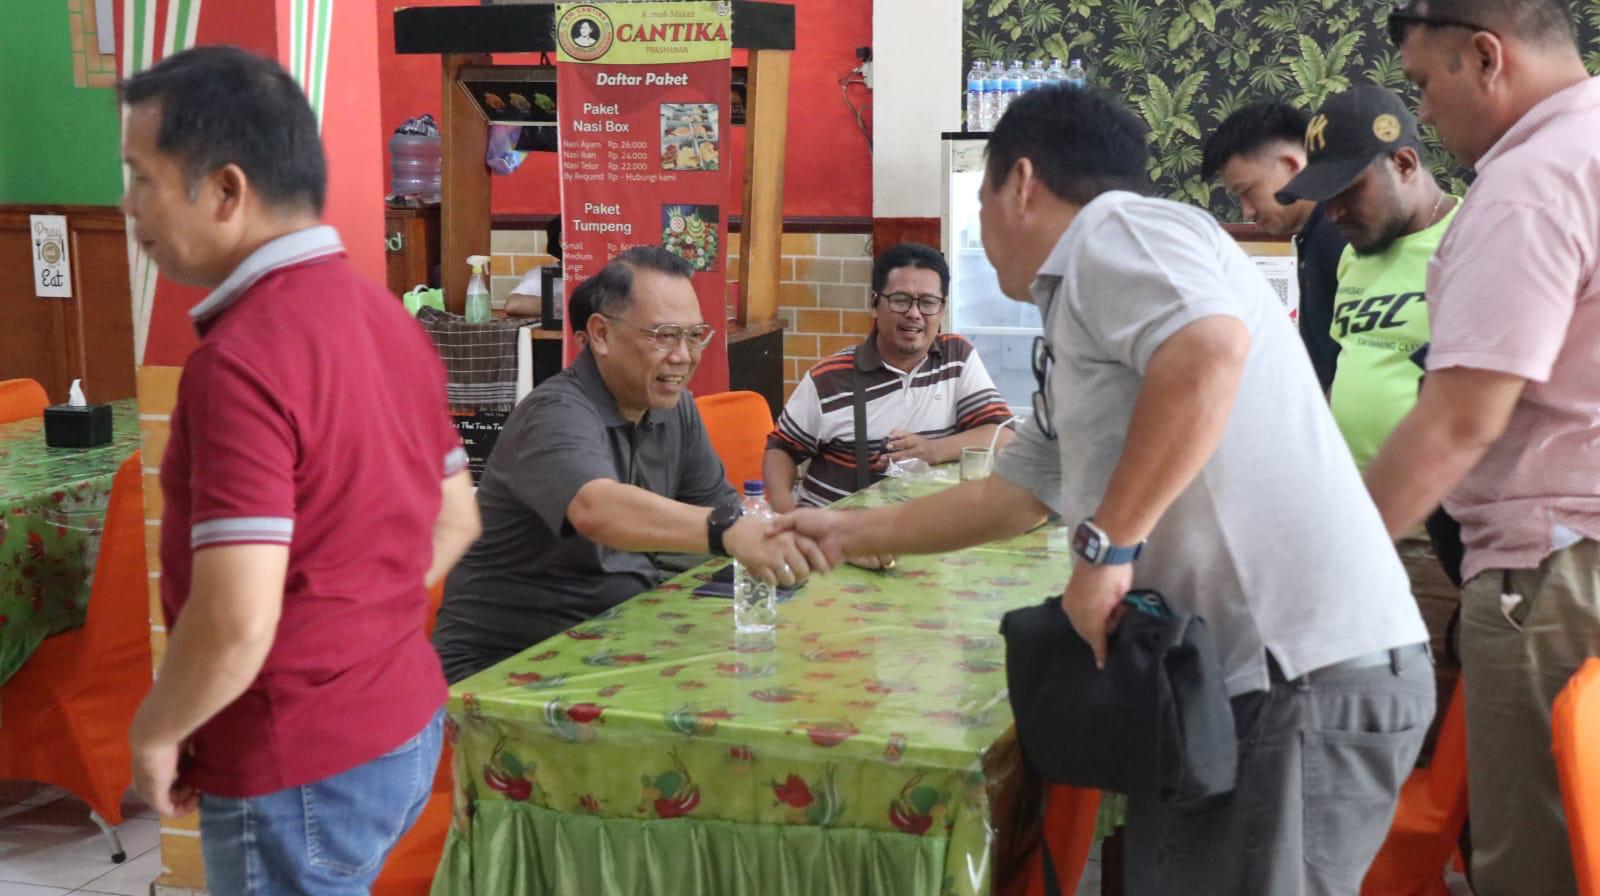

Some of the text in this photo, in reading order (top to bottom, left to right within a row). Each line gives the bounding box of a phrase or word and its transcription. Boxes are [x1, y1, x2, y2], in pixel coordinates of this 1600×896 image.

[616, 23, 728, 43] CANTIKA
[646, 46, 689, 54] PRASMANAN
[596, 72, 689, 86] Daftar Paket
[583, 103, 620, 115] Paket
[573, 120, 630, 133] Nasi Box
[562, 140, 579, 148] Nasi
[580, 140, 602, 150] Ayam
[621, 141, 647, 149] 26.000
[563, 151, 579, 159] Nasi
[581, 151, 597, 159] Ikan
[621, 152, 647, 160] 24.000
[563, 162, 579, 170] Nasi
[580, 162, 599, 170] Telur
[574, 173, 604, 182] Request
[626, 173, 657, 183] Hubungi
[659, 173, 676, 181] kami
[584, 203, 621, 215] Paket
[573, 219, 632, 234] Tumpeng
[563, 241, 583, 250] Small
[563, 253, 593, 261] Medium
[41, 268, 64, 287] Eat
[1334, 292, 1426, 338] SSC
